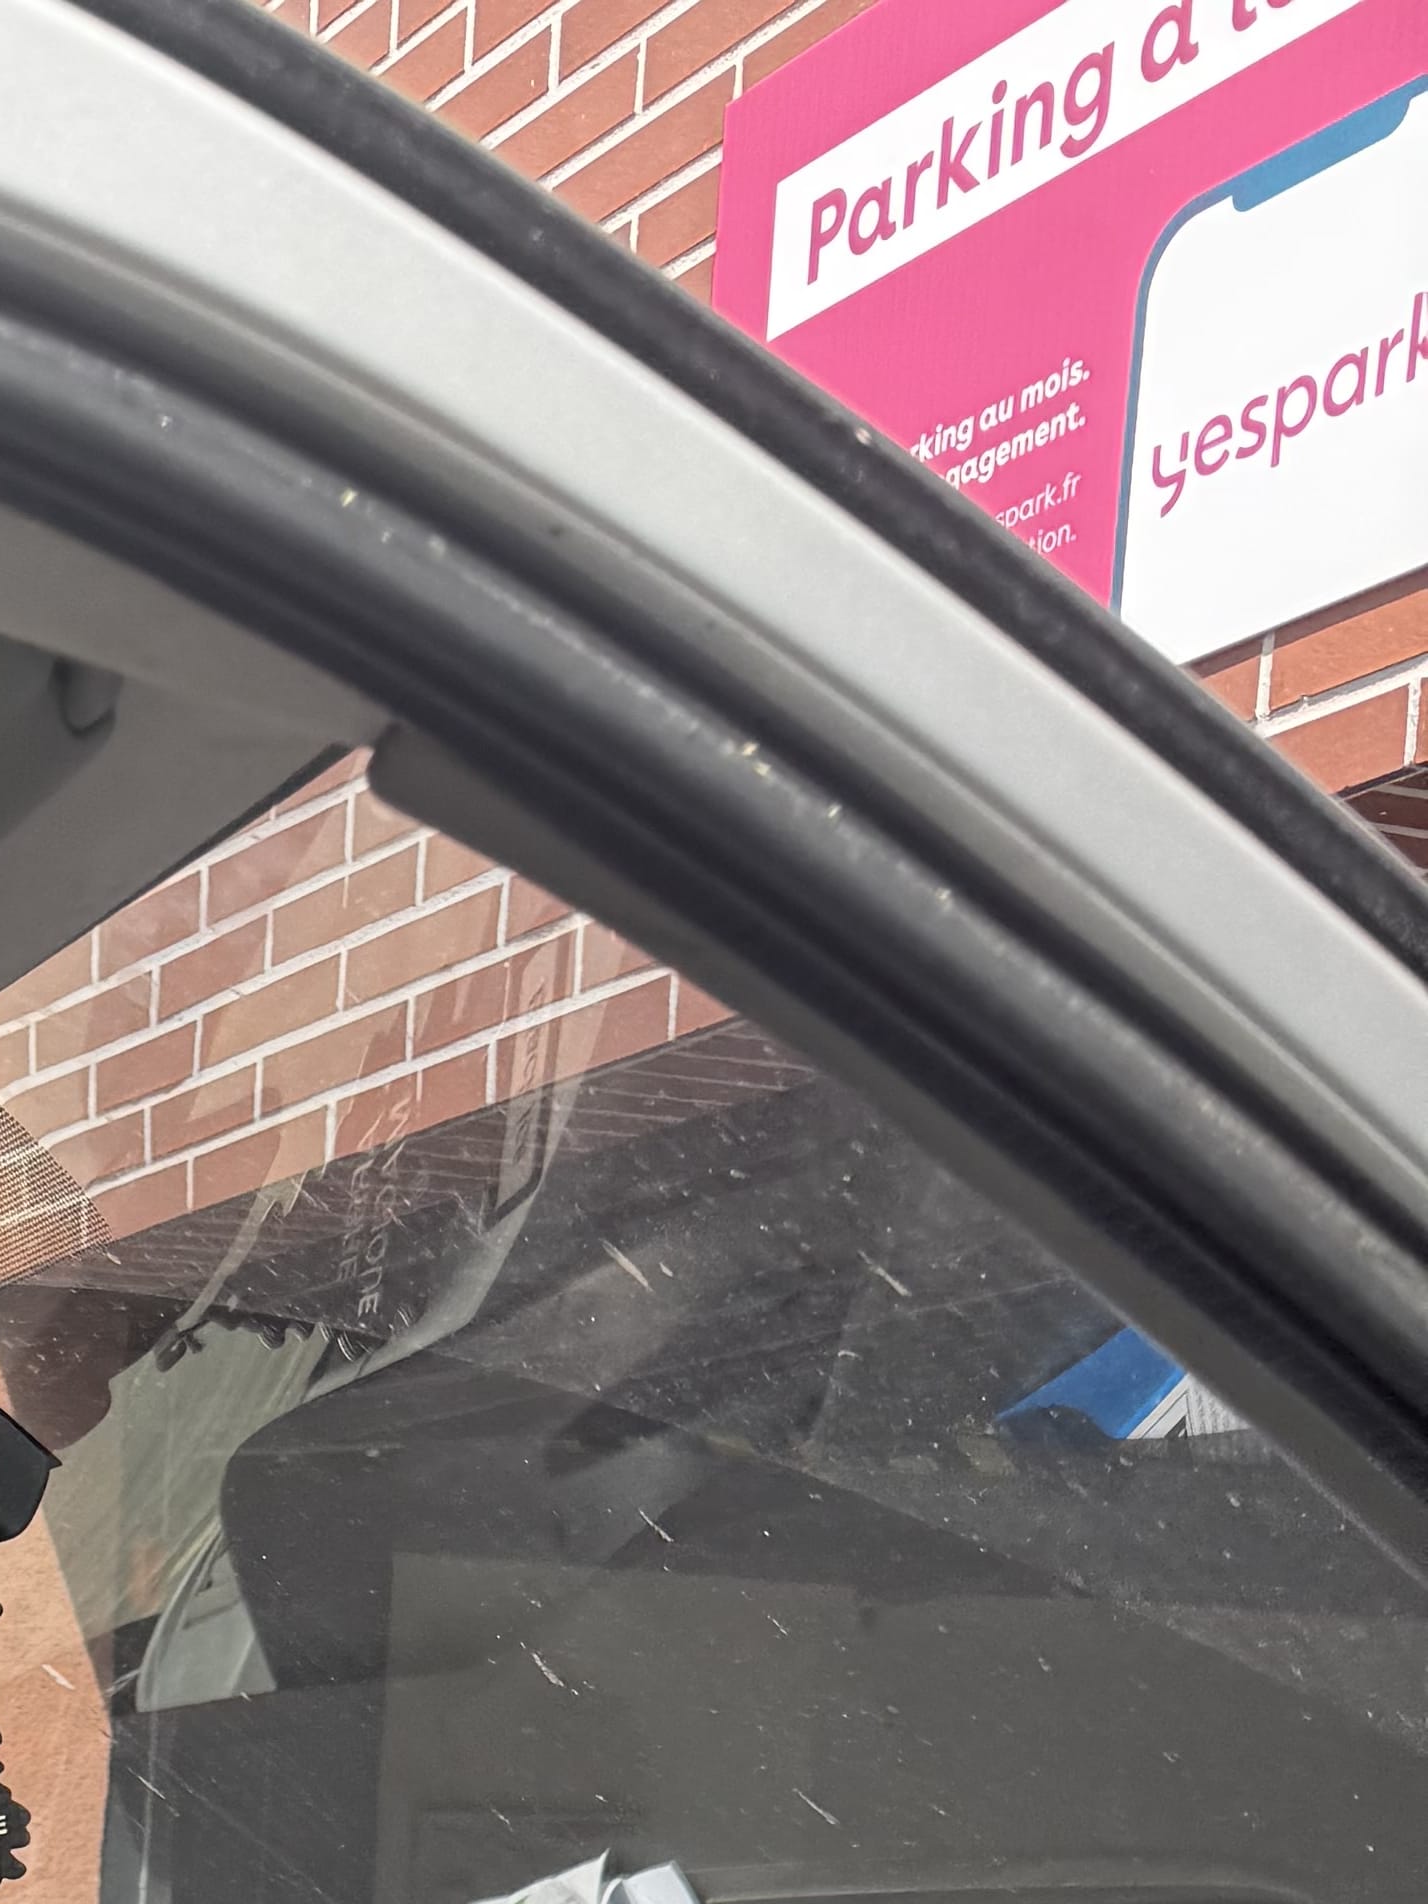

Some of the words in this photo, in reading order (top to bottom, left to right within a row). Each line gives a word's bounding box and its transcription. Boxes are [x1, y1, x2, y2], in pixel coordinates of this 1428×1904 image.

[807, 41, 1115, 286] Parking
[979, 395, 1014, 432] au
[1020, 357, 1090, 413] mois.
